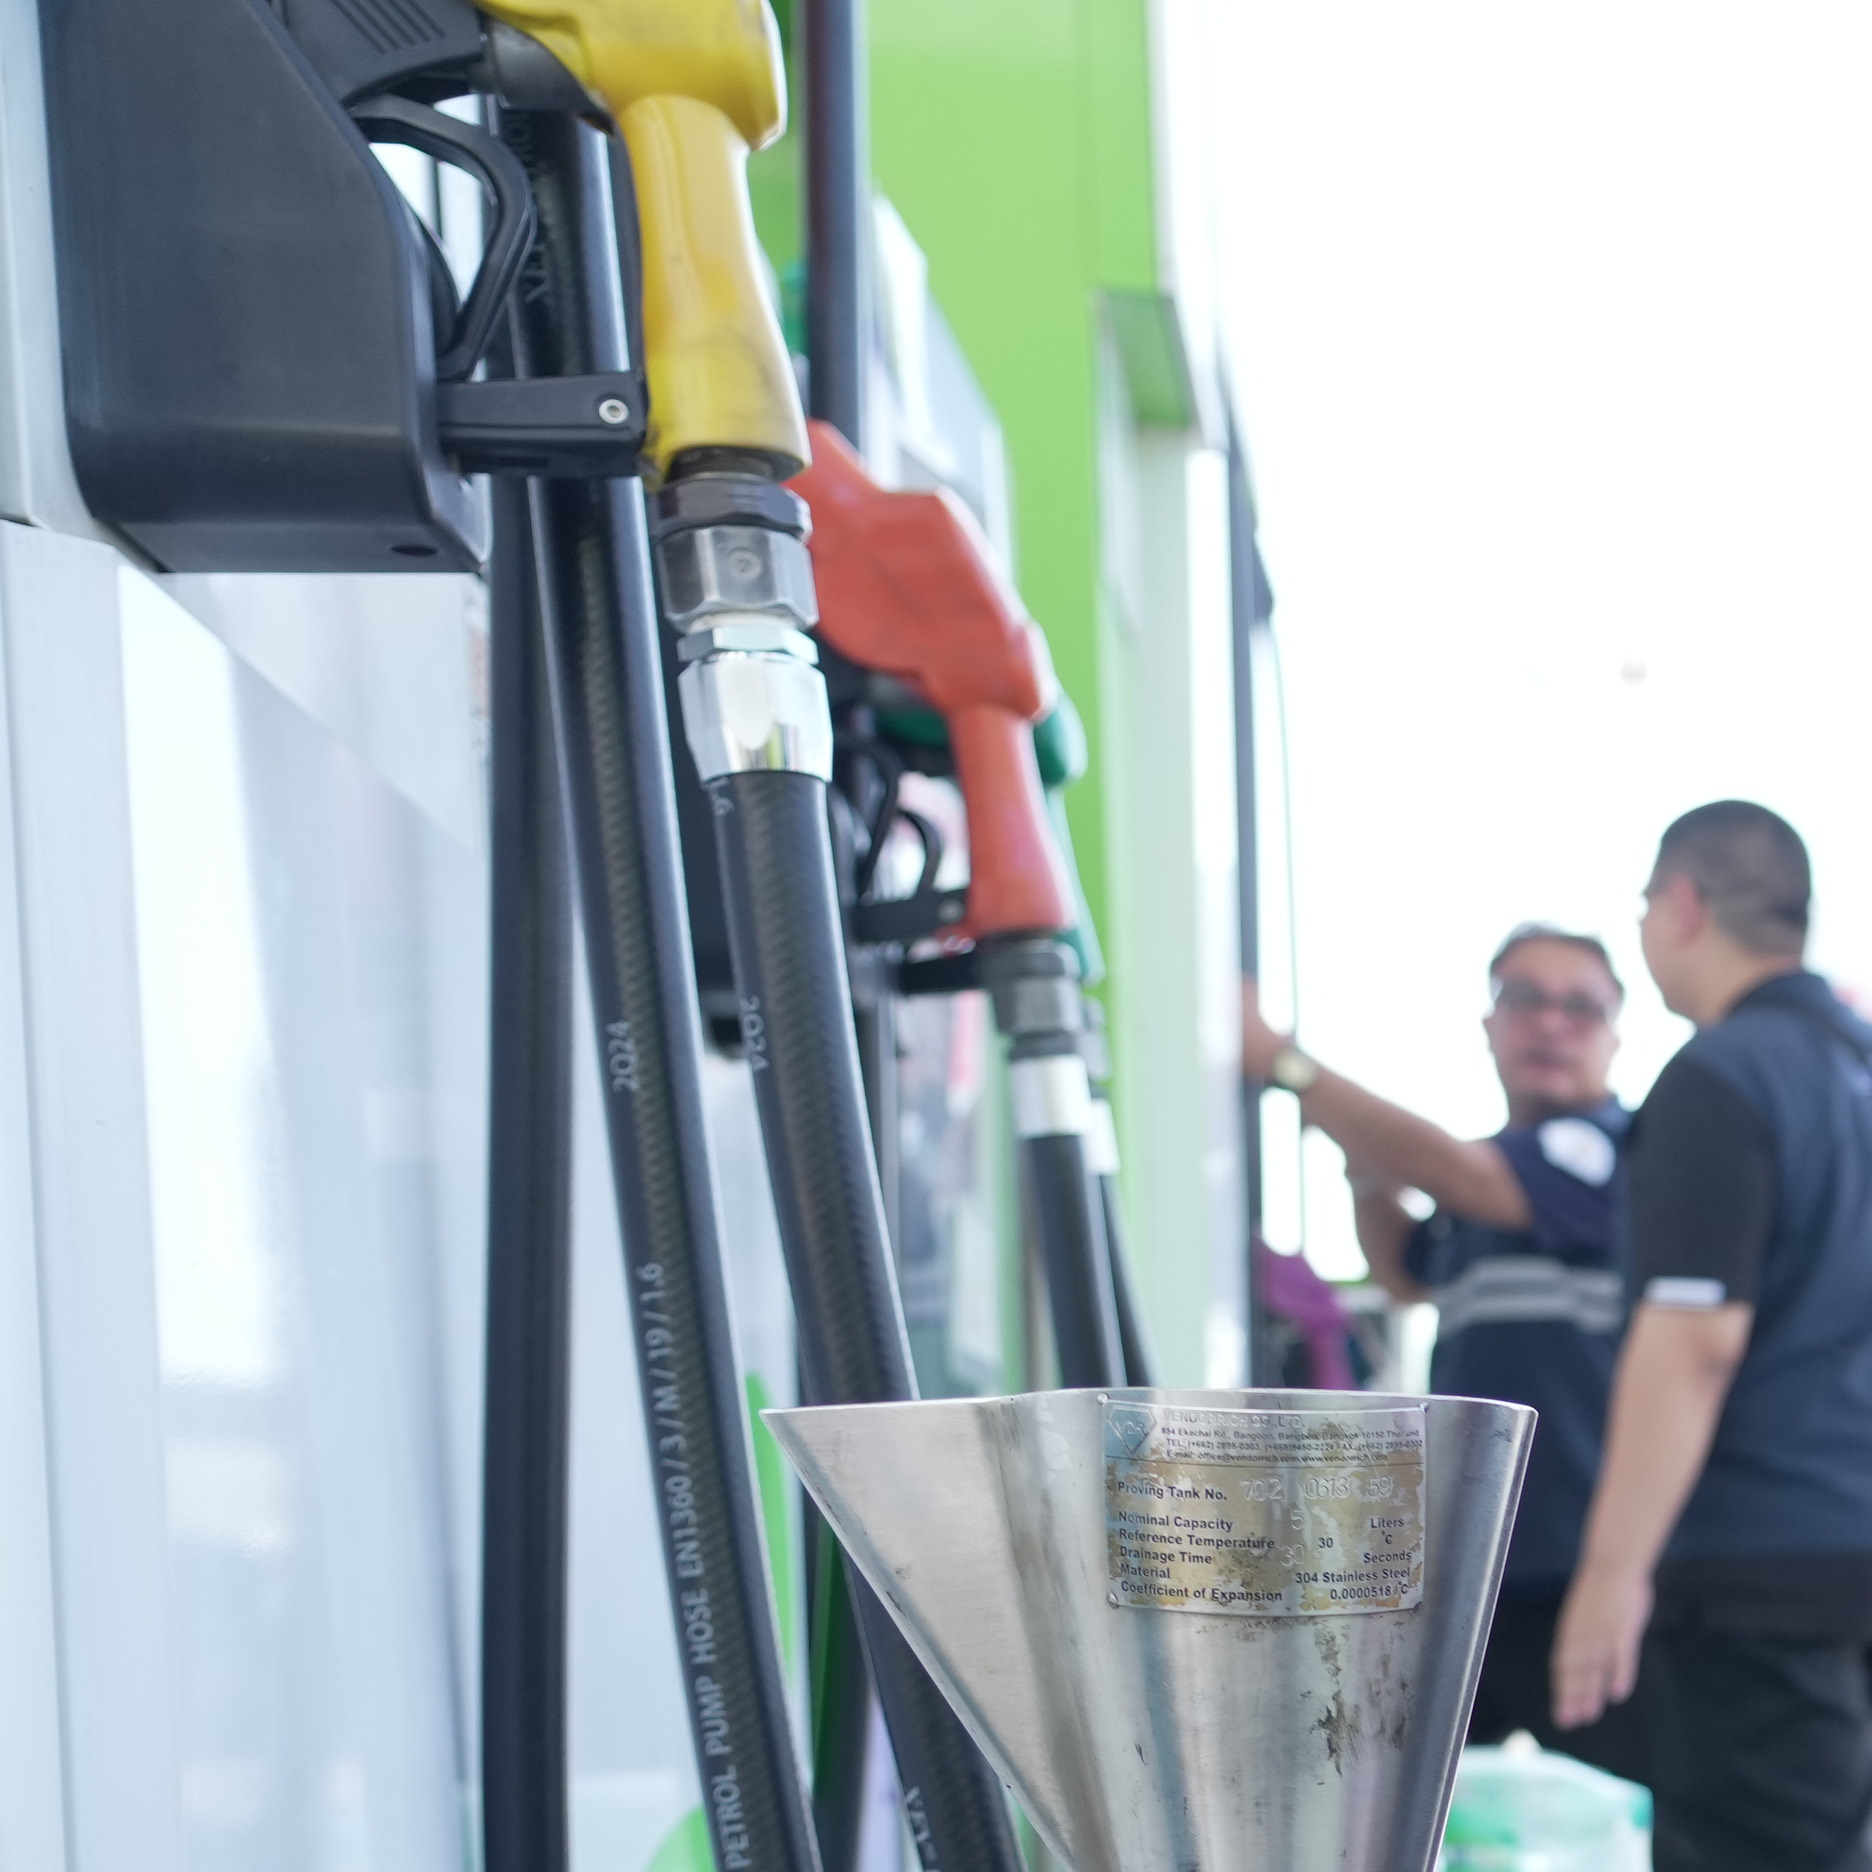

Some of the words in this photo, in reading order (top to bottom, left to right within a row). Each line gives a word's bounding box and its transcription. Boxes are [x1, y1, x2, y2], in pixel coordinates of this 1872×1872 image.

[1117, 1481, 1164, 1499] Proving
[1168, 1486, 1200, 1499] Tank
[1205, 1488, 1227, 1500] No.
[1118, 1511, 1169, 1527] Nominal
[1174, 1516, 1233, 1533] Capacity
[1370, 1518, 1404, 1529] Liters
[1119, 1528, 1183, 1545] Reference
[1187, 1534, 1276, 1550] Temperature
[1318, 1537, 1333, 1548] 30
[1119, 1546, 1175, 1563] Drainage
[1180, 1551, 1213, 1564] Time
[1363, 1550, 1412, 1564] Seconds
[1120, 1563, 1171, 1579] Material
[1295, 1572, 1319, 1584] 304
[1323, 1570, 1379, 1583] Stainless
[1382, 1567, 1410, 1579] Steel
[1121, 1581, 1189, 1598] Coefficient
[1194, 1588, 1206, 1599] of
[1211, 1589, 1282, 1602] Expansion
[681, 1587, 718, 1665] HOSE
[695, 1675, 733, 1756] PUMP
[711, 1764, 752, 1870] PETROL
